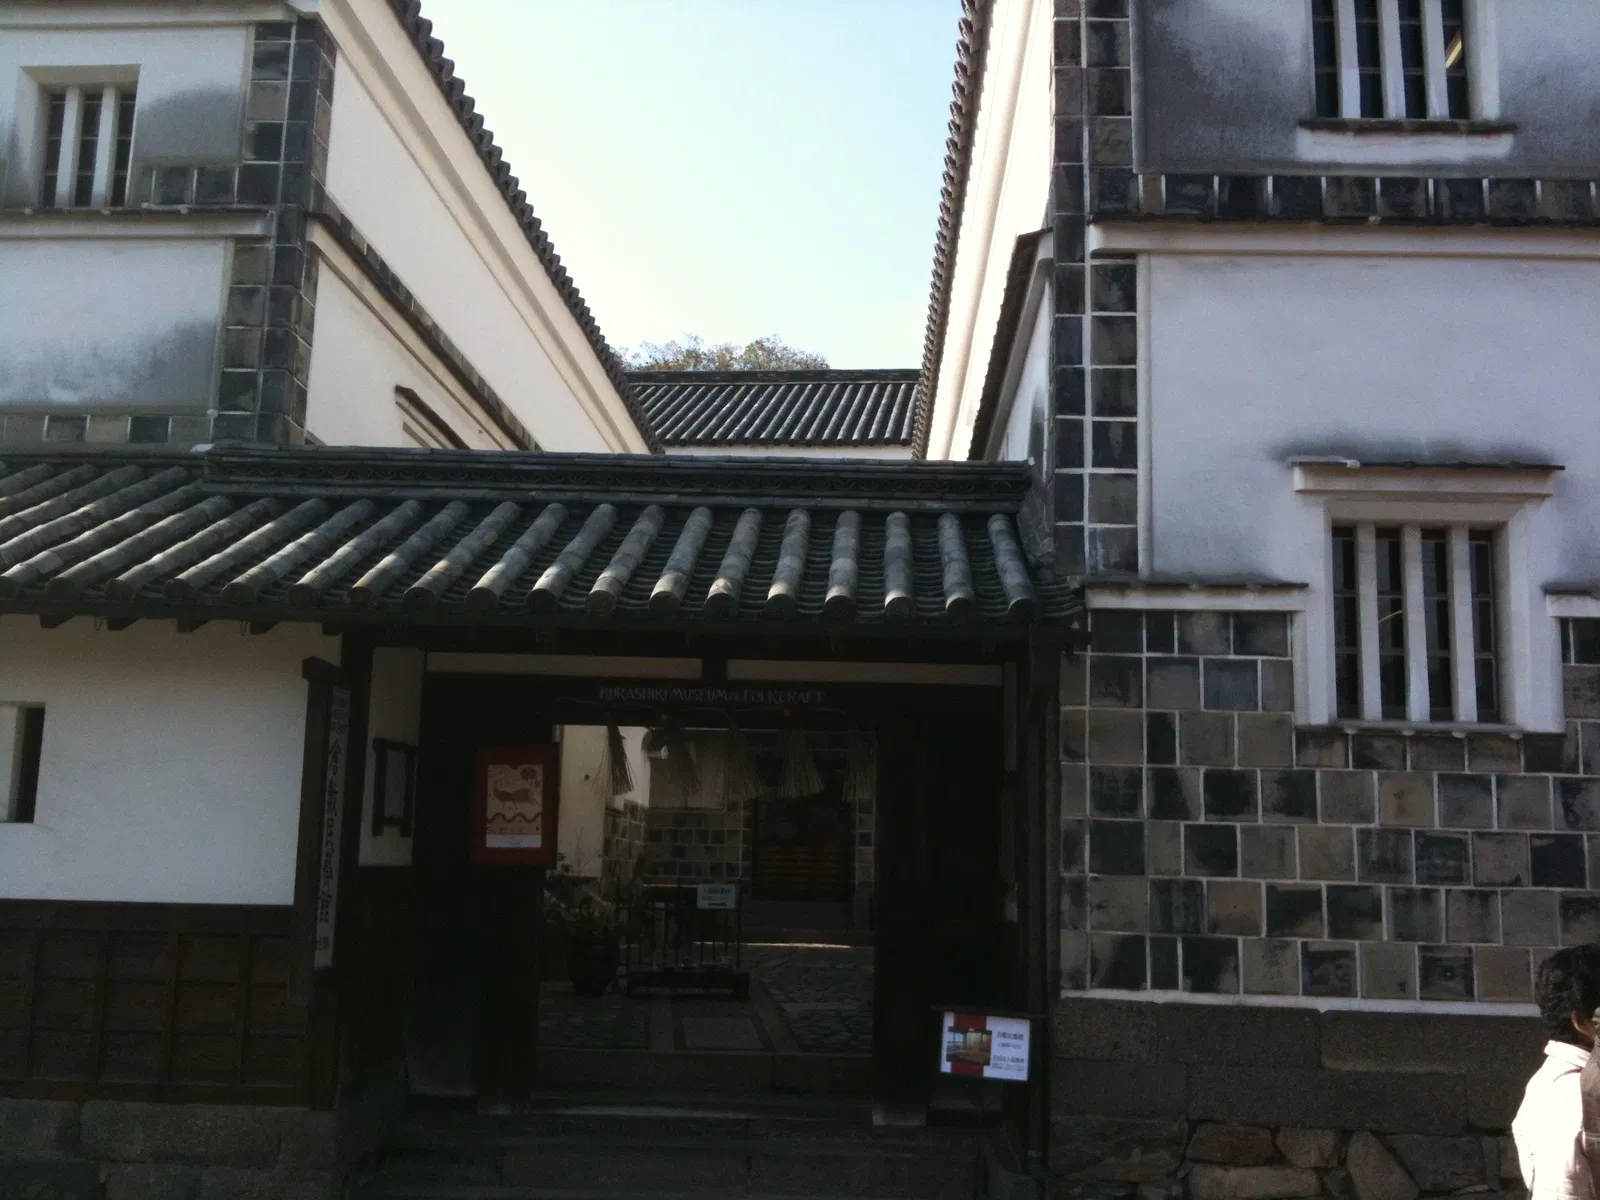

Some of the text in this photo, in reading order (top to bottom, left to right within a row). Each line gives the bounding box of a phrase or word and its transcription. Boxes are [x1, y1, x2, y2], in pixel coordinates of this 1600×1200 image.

[599, 687, 668, 702] KURASHIKI
[669, 687, 728, 702] MUSEUM
[743, 688, 824, 705] FOLKCRAFT
